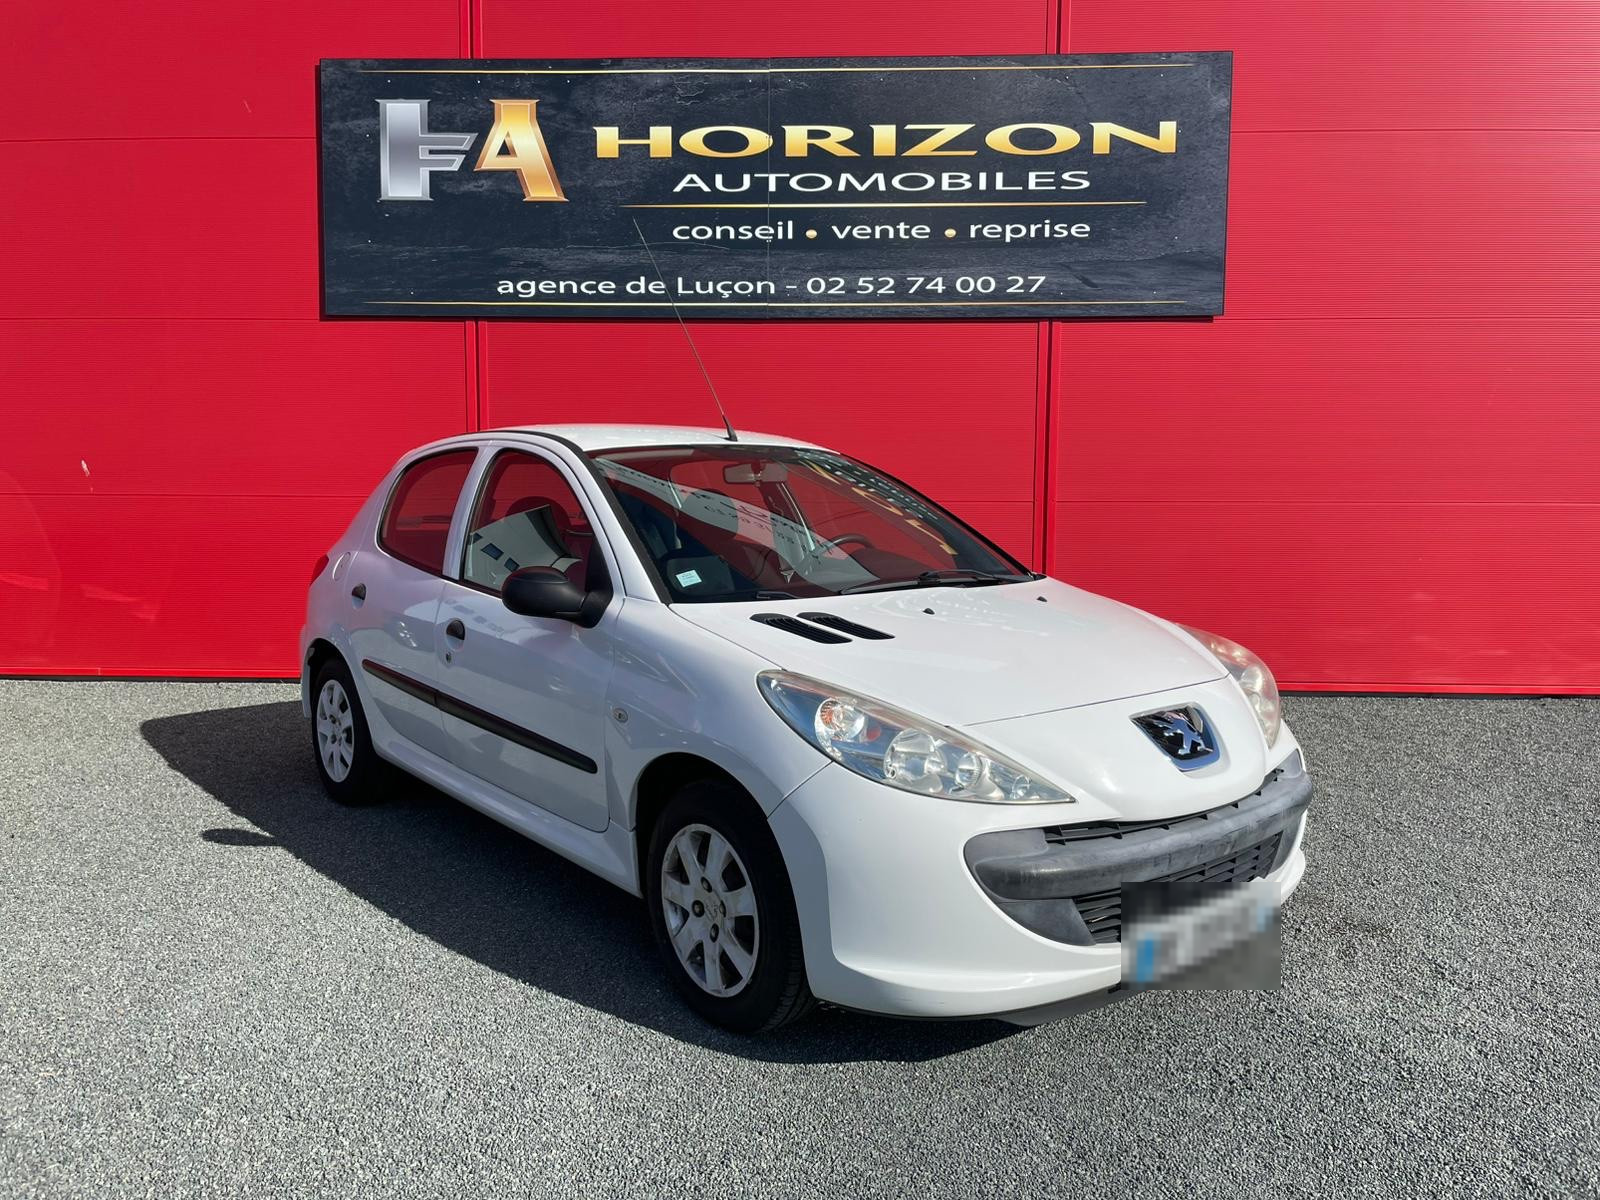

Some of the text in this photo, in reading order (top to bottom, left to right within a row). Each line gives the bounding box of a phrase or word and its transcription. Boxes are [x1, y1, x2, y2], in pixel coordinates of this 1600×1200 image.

[593, 120, 1177, 158] HORIZON
[673, 170, 1091, 193] AUTOMOBILES
[672, 219, 1091, 243] conseil vente reprise
[496, 280, 617, 298] agence
[625, 275, 666, 295] de
[677, 276, 776, 299] Luçon
[806, 276, 846, 295] 02
[856, 276, 896, 295] 52
[906, 276, 947, 294] 74
[955, 276, 996, 294] 00
[1005, 275, 1047, 293] 27
